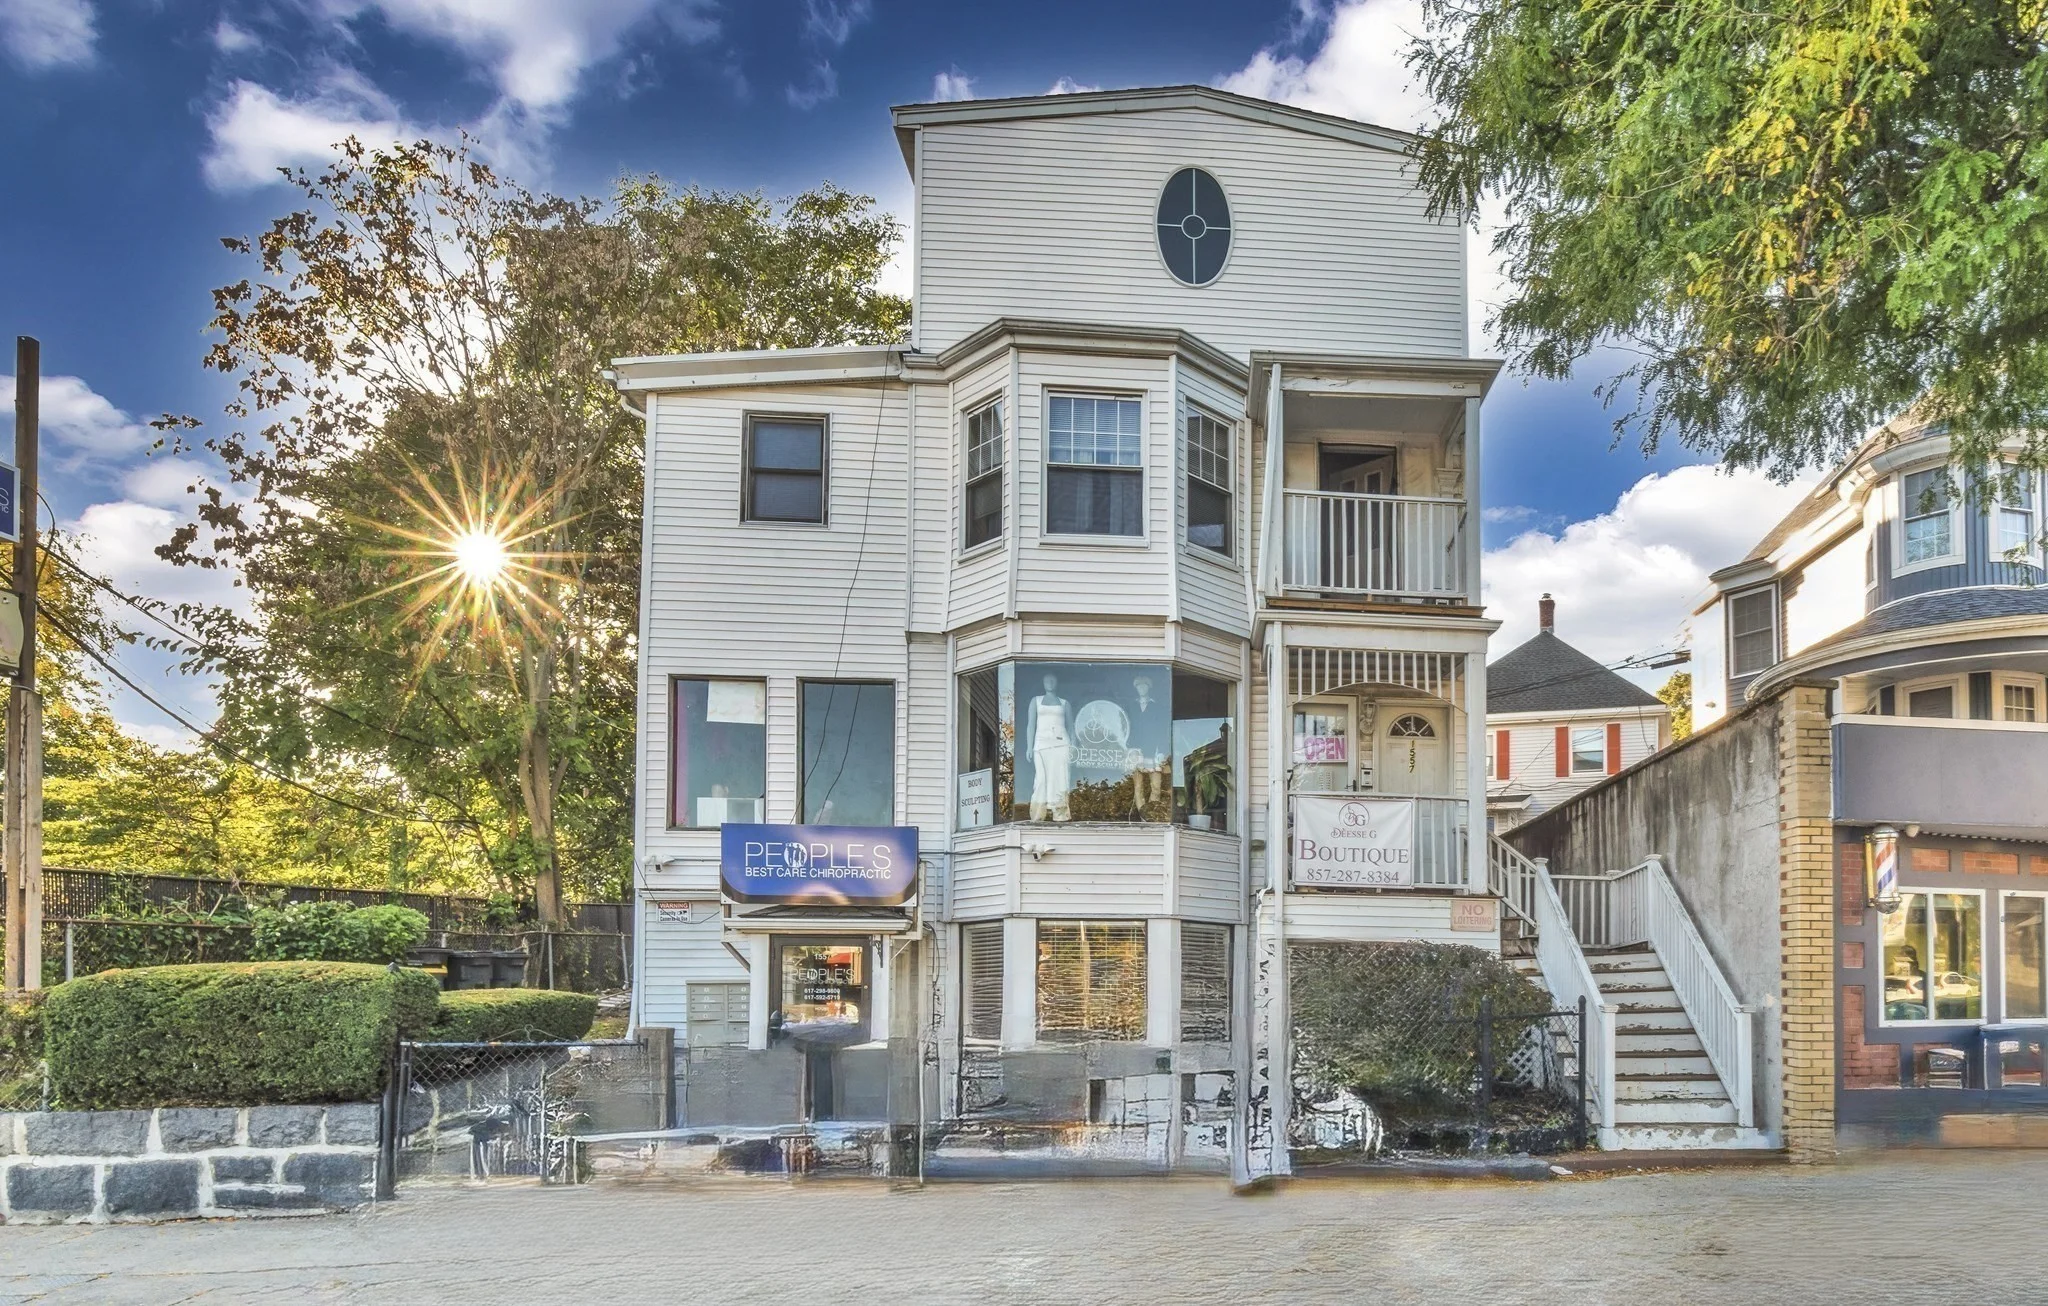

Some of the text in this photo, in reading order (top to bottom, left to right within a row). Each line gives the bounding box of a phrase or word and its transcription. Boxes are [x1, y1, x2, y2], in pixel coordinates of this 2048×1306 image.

[1304, 737, 1345, 760] OPEN
[967, 777, 983, 788] BODY
[961, 794, 990, 807] SCULPTING
[1369, 829, 1377, 839] G
[1298, 838, 1409, 867] BOUTIQUE
[745, 867, 892, 879] BEST CARE CHIROPRACTIC
[1307, 868, 1400, 883] 857-287-8384
[1461, 904, 1484, 916] NO
[1453, 916, 1492, 926] LOITERING
